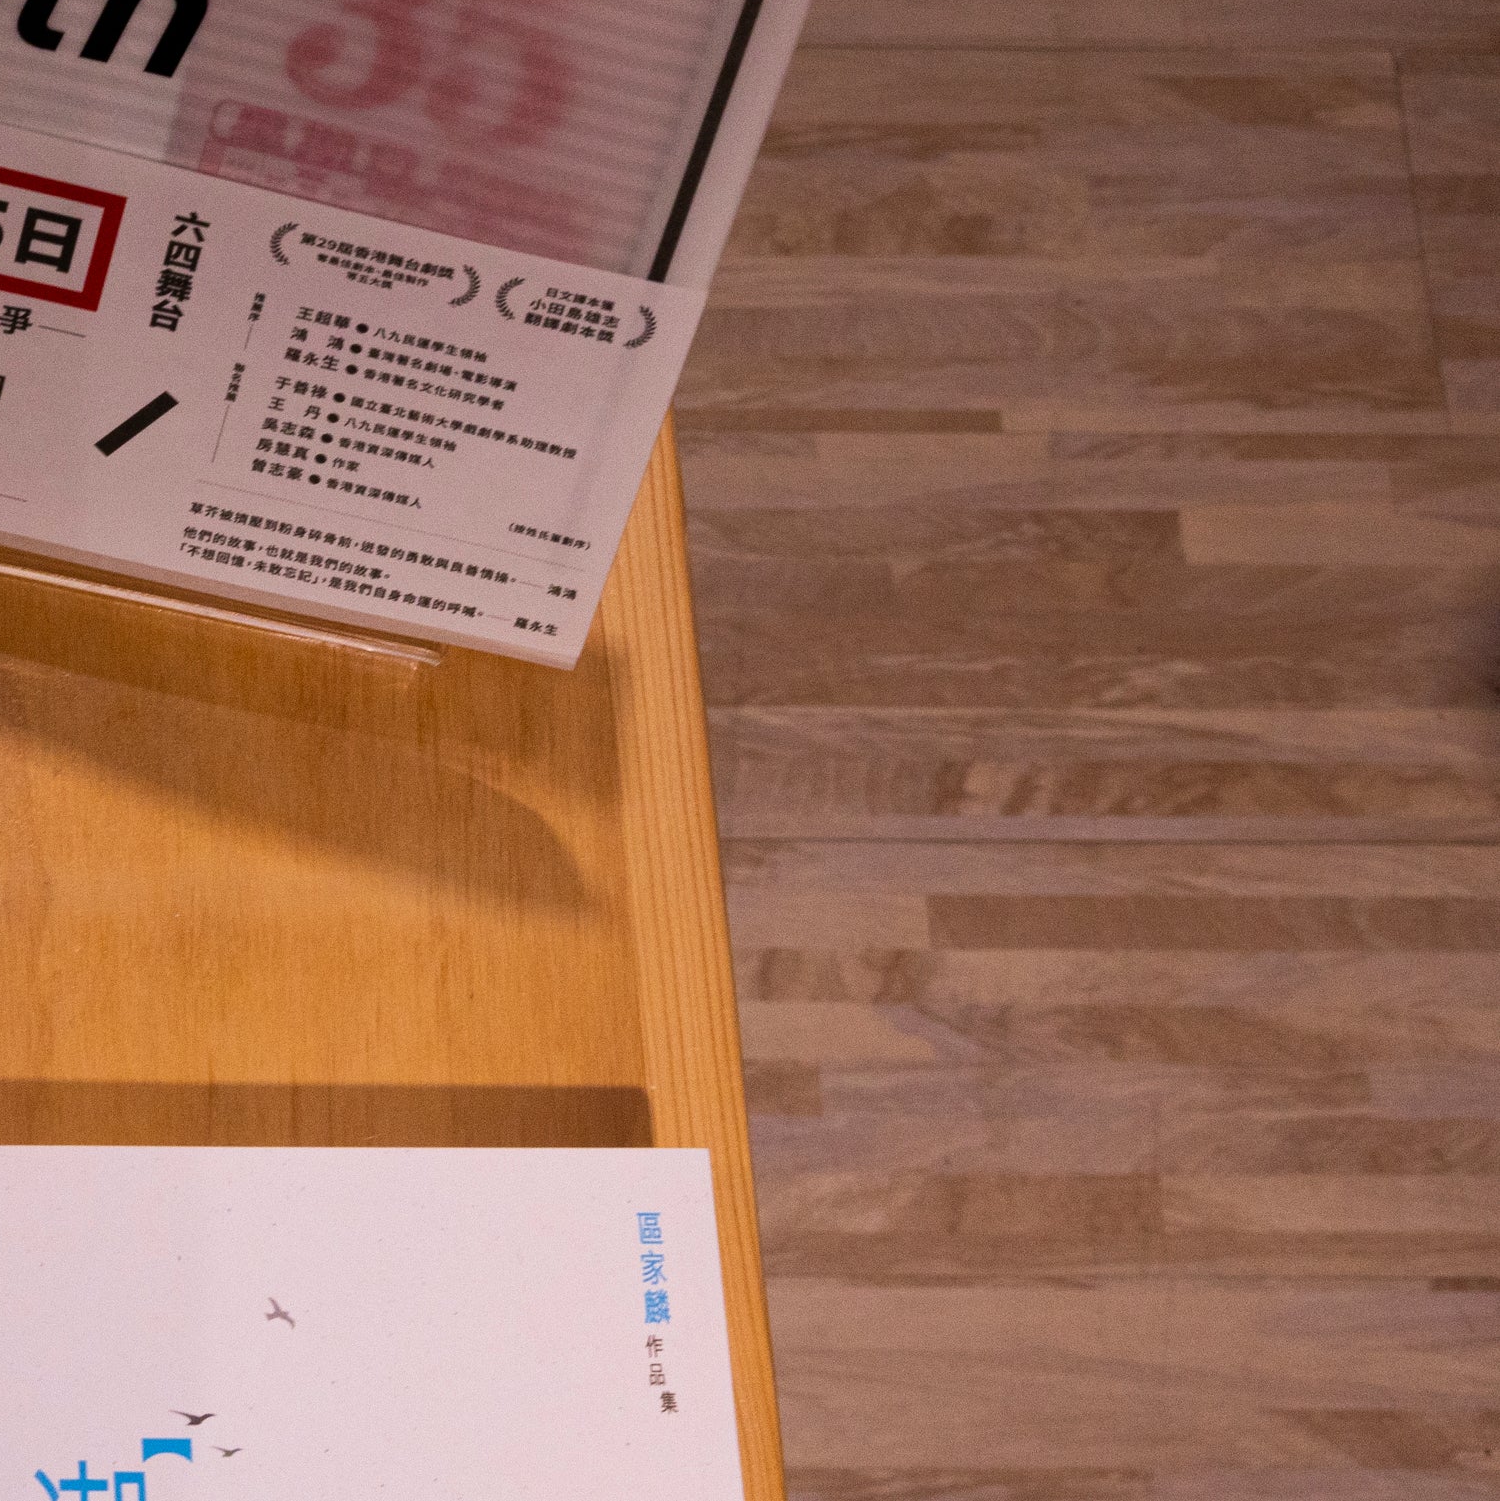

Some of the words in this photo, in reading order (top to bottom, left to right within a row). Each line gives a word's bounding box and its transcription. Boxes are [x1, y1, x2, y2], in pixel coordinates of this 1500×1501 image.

[149, 211, 211, 332] 六四舞台
[528, 297, 621, 331] 小田島雄志
[283, 347, 340, 373] 羅永生
[331, 457, 361, 474] 作家
[635, 1211, 672, 1326] 區家麟
[645, 1333, 679, 1415] 作品集
